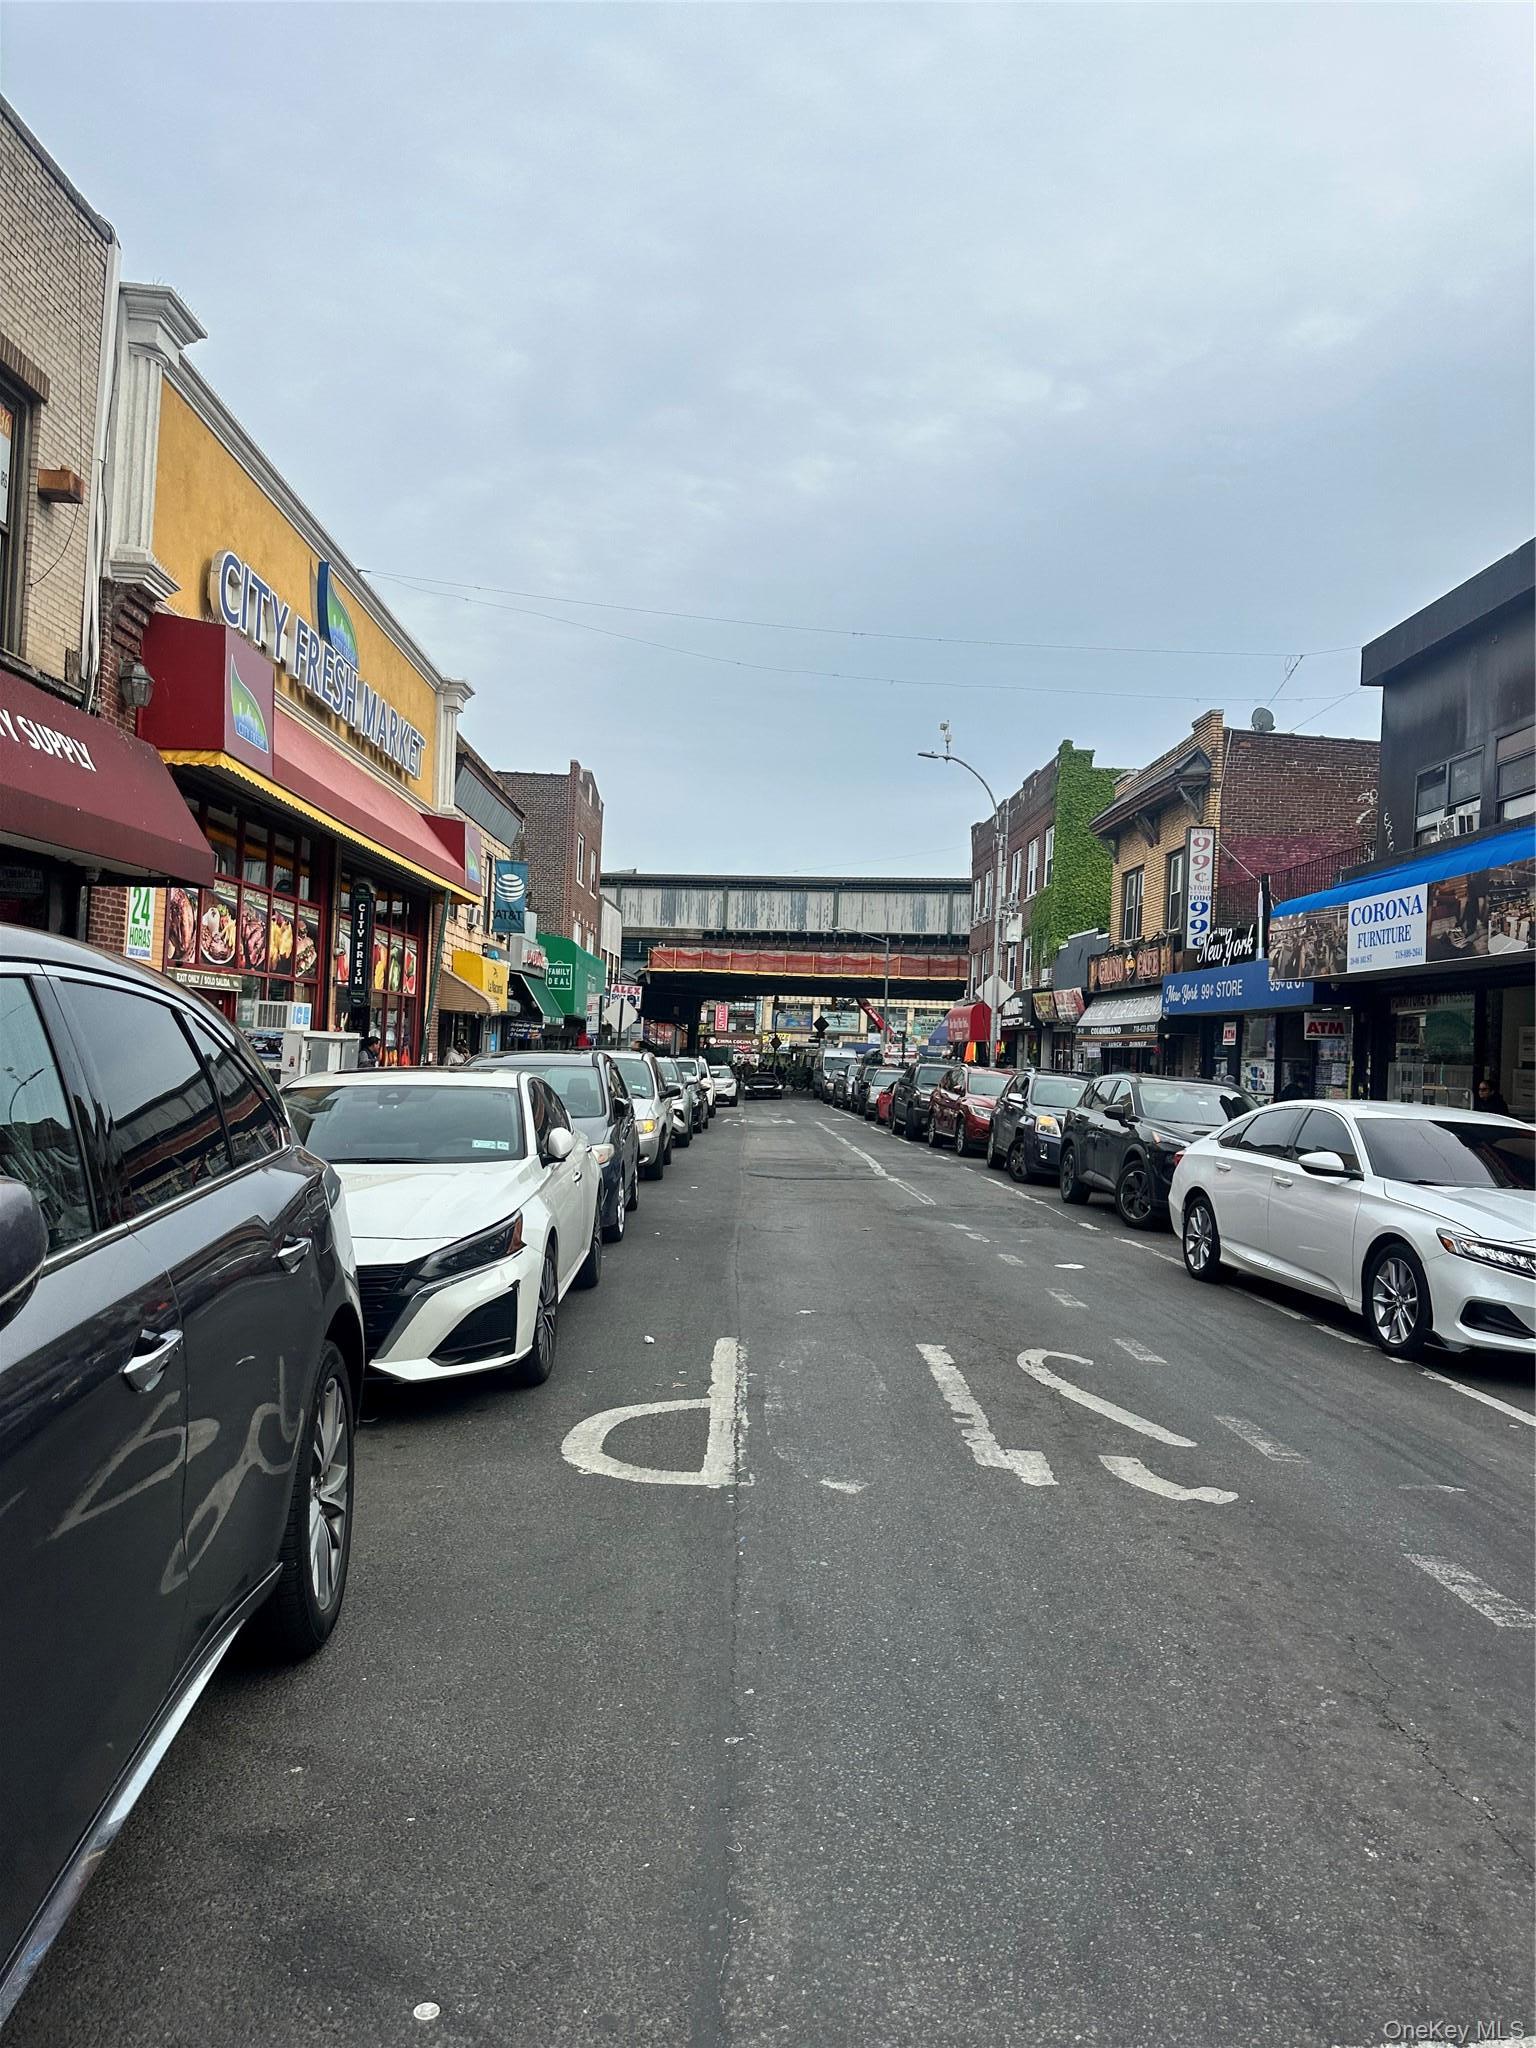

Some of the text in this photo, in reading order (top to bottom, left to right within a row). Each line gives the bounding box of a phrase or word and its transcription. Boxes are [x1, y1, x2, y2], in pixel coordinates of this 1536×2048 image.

[219, 550, 426, 780] CITY FRESH MARKET
[16, 715, 97, 772] SUPPLY
[131, 886, 151, 927] 24
[494, 910, 523, 921] AT&T
[1351, 894, 1424, 927] CORONA
[129, 927, 152, 949] HORAS
[354, 903, 367, 985] CITY FRESH
[1197, 924, 1254, 967] New York
[1357, 924, 1412, 949] FURNITURE
[176, 972, 188, 983] EXIT
[188, 973, 200, 984] ONLY
[204, 975, 215, 985] SOLO
[216, 976, 231, 987] SALIDA
[548, 967, 571, 976] FAMILY
[548, 977, 570, 985] DEAL
[612, 985, 641, 995] ALEX
[1165, 985, 1181, 1004] New
[1182, 983, 1198, 1005] York
[1215, 979, 1243, 998] STORE
[1090, 1026, 1122, 1035] COLOMBIANO
[1223, 1029, 1236, 1040] ATM
[1306, 1021, 1345, 1035] ATM
[561, 1336, 1239, 1504] STP
